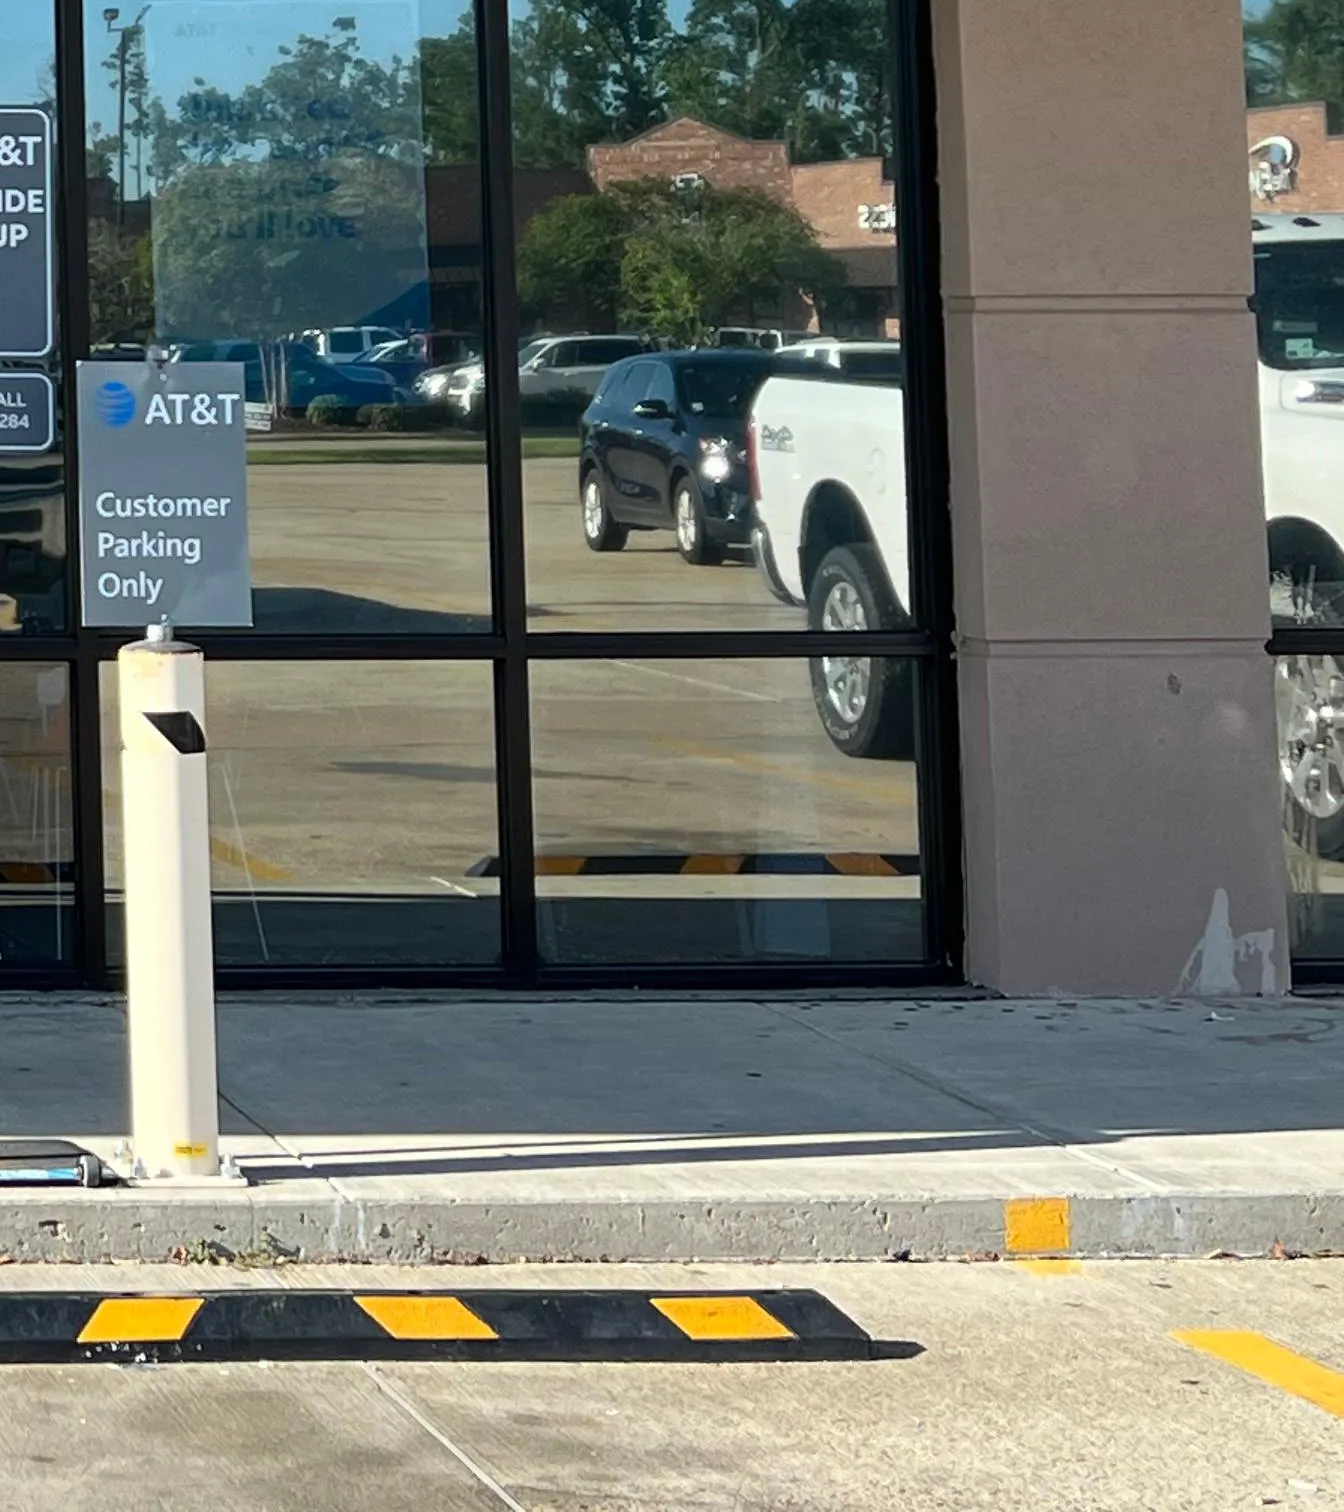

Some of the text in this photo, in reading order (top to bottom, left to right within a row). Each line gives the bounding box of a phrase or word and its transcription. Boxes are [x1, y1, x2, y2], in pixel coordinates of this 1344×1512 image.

[144, 393, 241, 425] AT&T
[96, 491, 232, 518] Customer
[97, 530, 202, 565] Parking
[98, 571, 164, 605] Only
